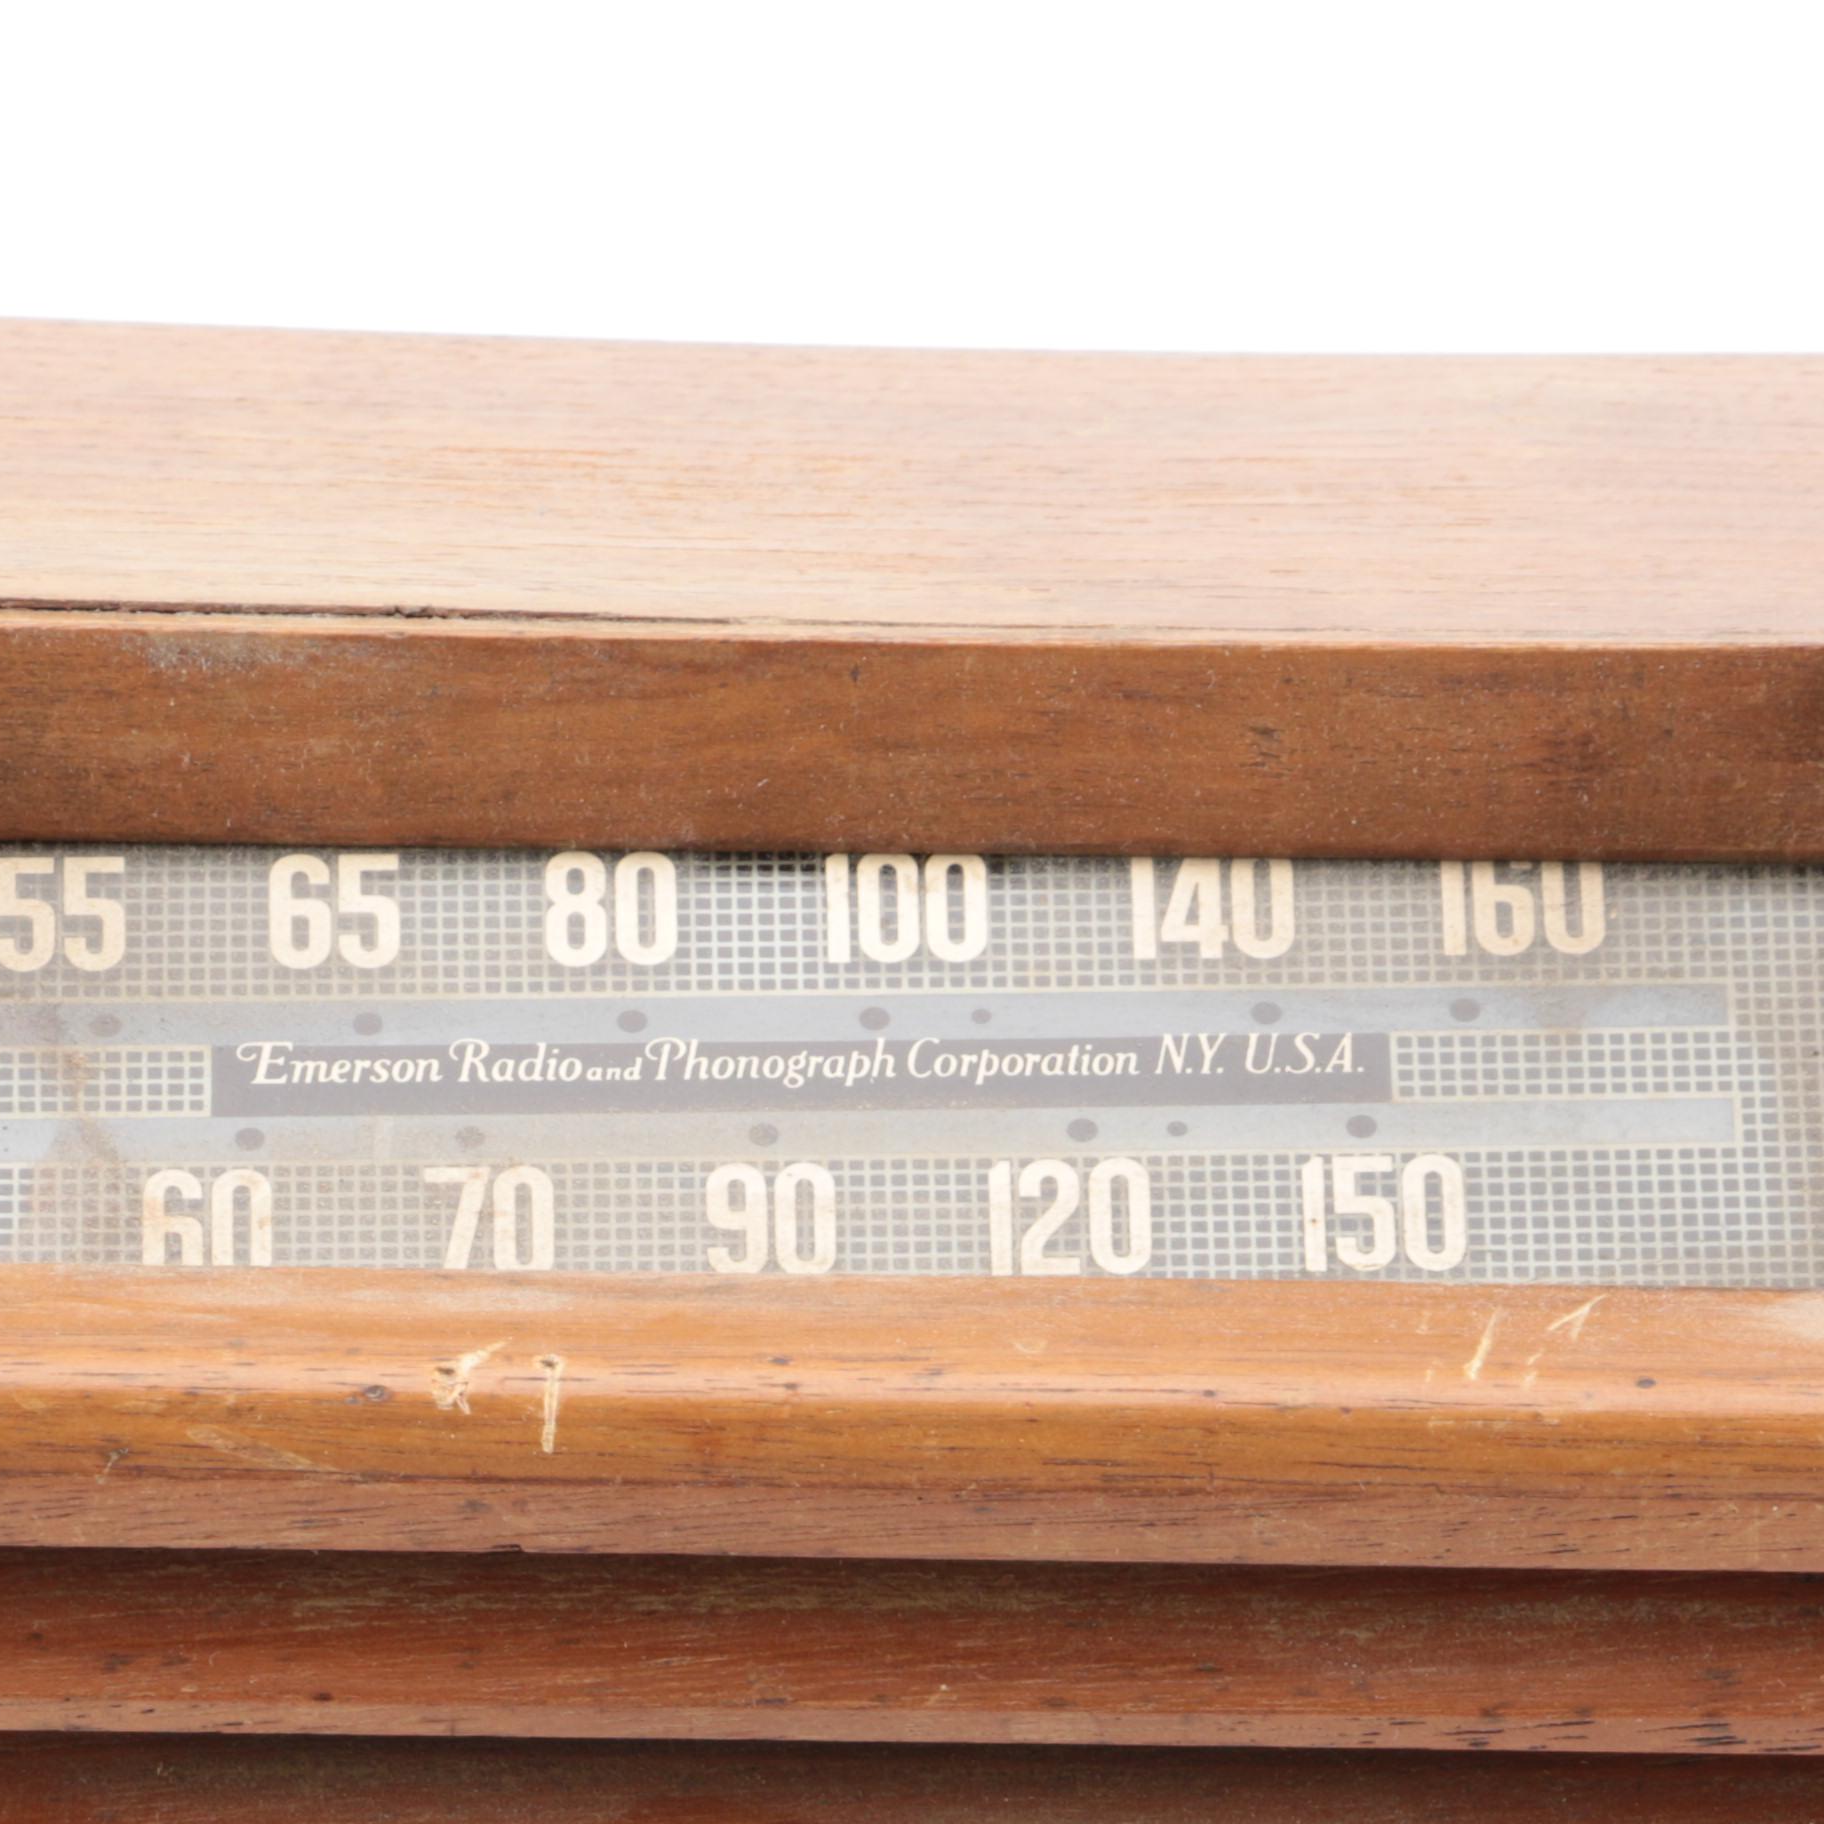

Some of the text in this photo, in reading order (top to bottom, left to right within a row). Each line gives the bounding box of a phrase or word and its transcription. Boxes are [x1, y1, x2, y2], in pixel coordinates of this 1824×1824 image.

[267, 853, 400, 968] 65
[542, 851, 679, 967] 80
[824, 852, 988, 964] 100
[1130, 857, 1297, 961] 140
[1441, 860, 1608, 957] 160
[234, 1039, 443, 1088] Emerson
[448, 1036, 583, 1084] Radio
[587, 1057, 642, 1082] and
[643, 1035, 896, 1088] Phonograph
[906, 1037, 1139, 1088] Corporation
[1245, 1031, 1366, 1074] U.S.A.
[141, 1152, 1468, 1276] 60 70 90 120 150
